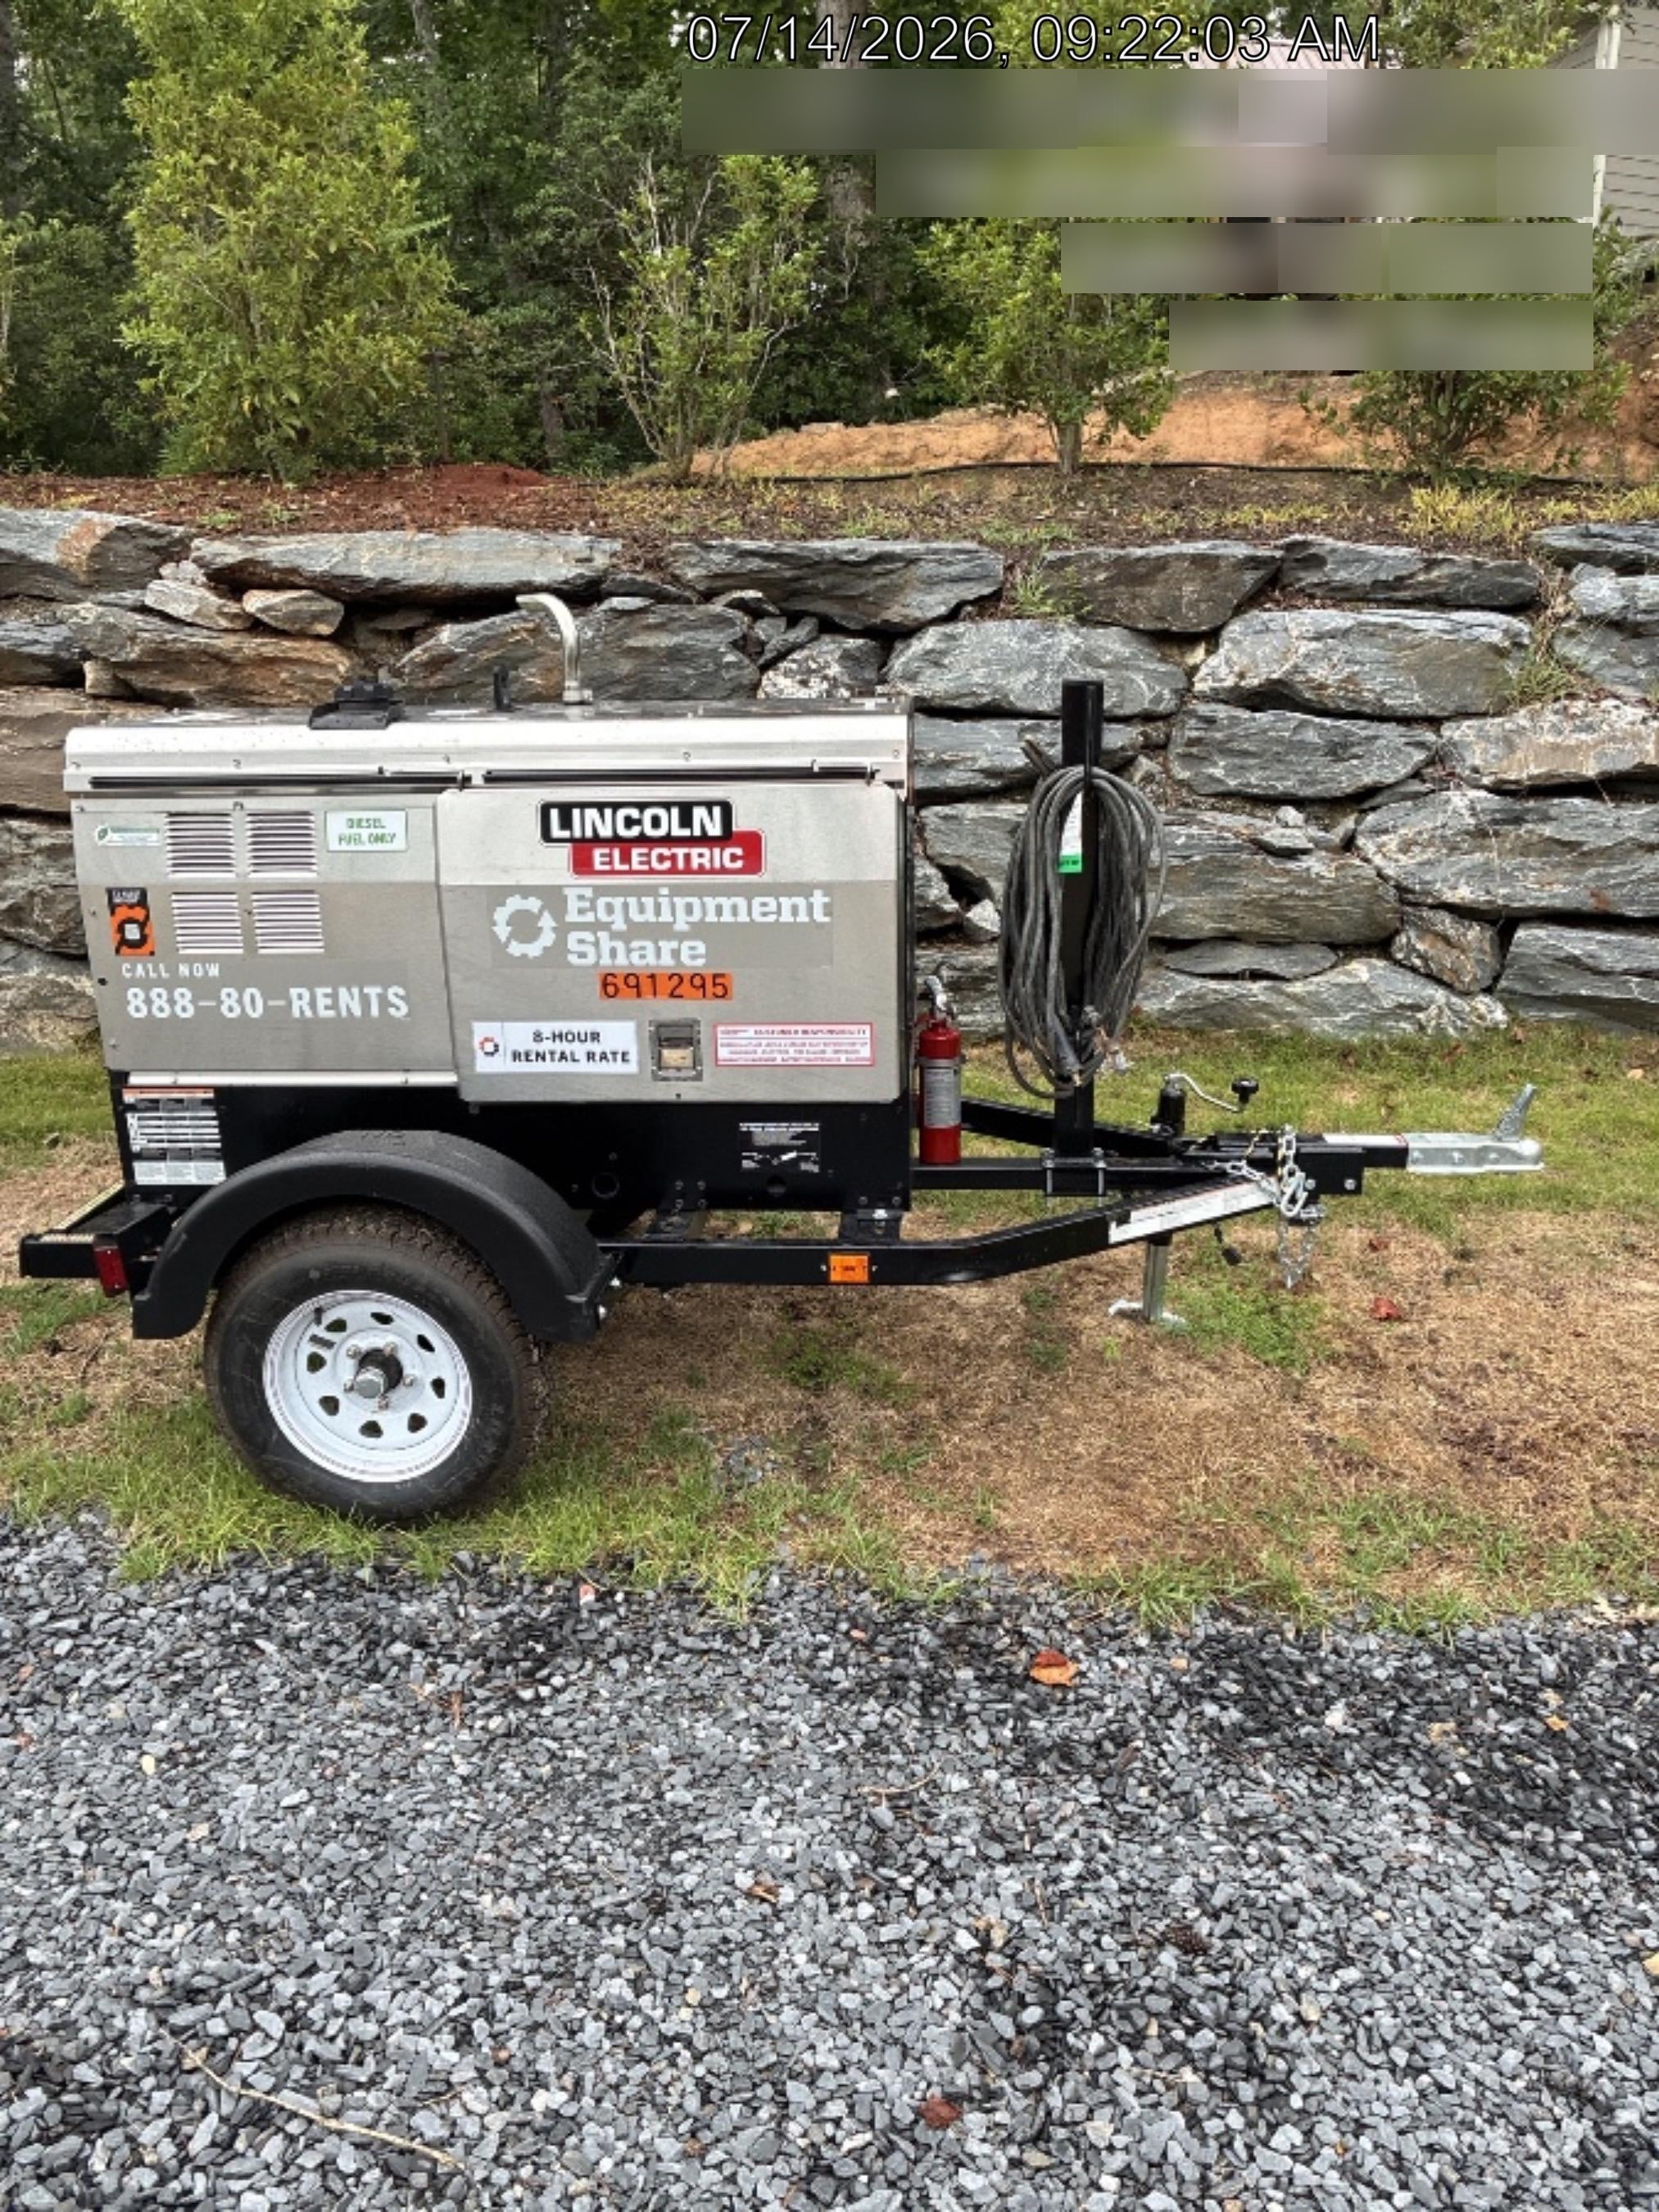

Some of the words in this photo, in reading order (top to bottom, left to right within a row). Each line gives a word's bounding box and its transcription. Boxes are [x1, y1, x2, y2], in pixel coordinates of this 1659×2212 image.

[346, 818, 386, 829] DIESEL
[549, 805, 723, 839] LINCOLN
[592, 847, 745, 871] ELECTRIC
[563, 887, 831, 931] Equipment
[567, 931, 706, 967] Share
[122, 963, 170, 978] CALL
[178, 963, 220, 977] NOW
[602, 972, 728, 999] 691295
[126, 986, 409, 1018] 888-80-RENTS
[532, 1029, 601, 1044] 8-HOUR
[510, 1049, 581, 1063] RENTAL
[586, 1049, 631, 1063] RATE
